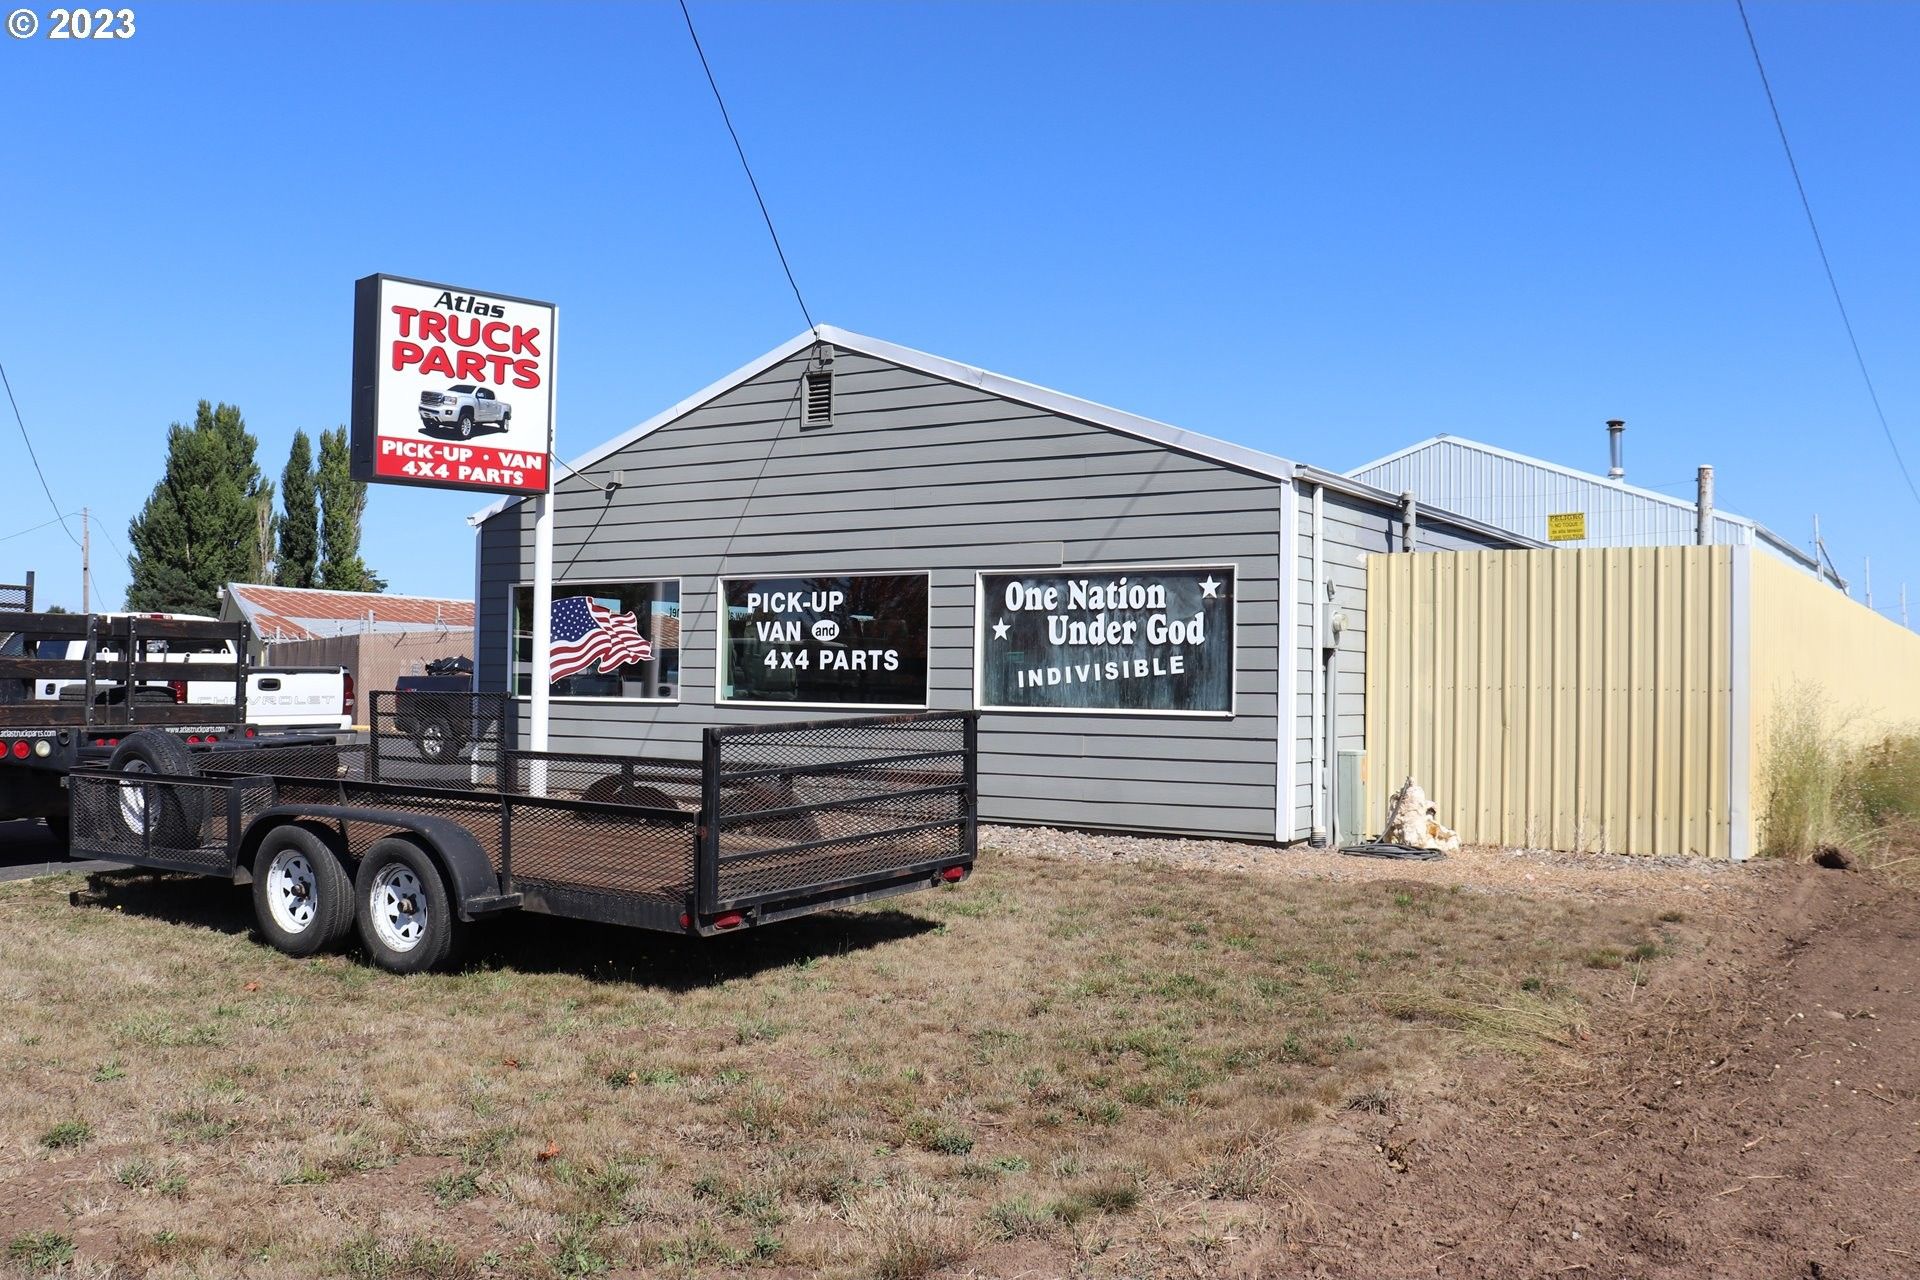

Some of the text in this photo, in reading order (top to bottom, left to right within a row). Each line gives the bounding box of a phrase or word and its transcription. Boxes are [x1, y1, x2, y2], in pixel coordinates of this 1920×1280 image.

[433, 291, 506, 319] Atlas
[391, 305, 541, 357] TRUCK
[392, 340, 541, 390] PARTS
[382, 439, 542, 470] PICK-UP VAN
[402, 460, 524, 485] 4X4 PARTS
[747, 591, 844, 613] PICK-UP
[1005, 577, 1166, 611] One Nation
[756, 621, 835, 642] VAN and
[1048, 611, 1206, 646] Under God
[763, 649, 899, 671] 4x4 PARTS
[1017, 655, 1185, 688] INDIVISIBLE
[197, 696, 336, 706] CHVROLET
